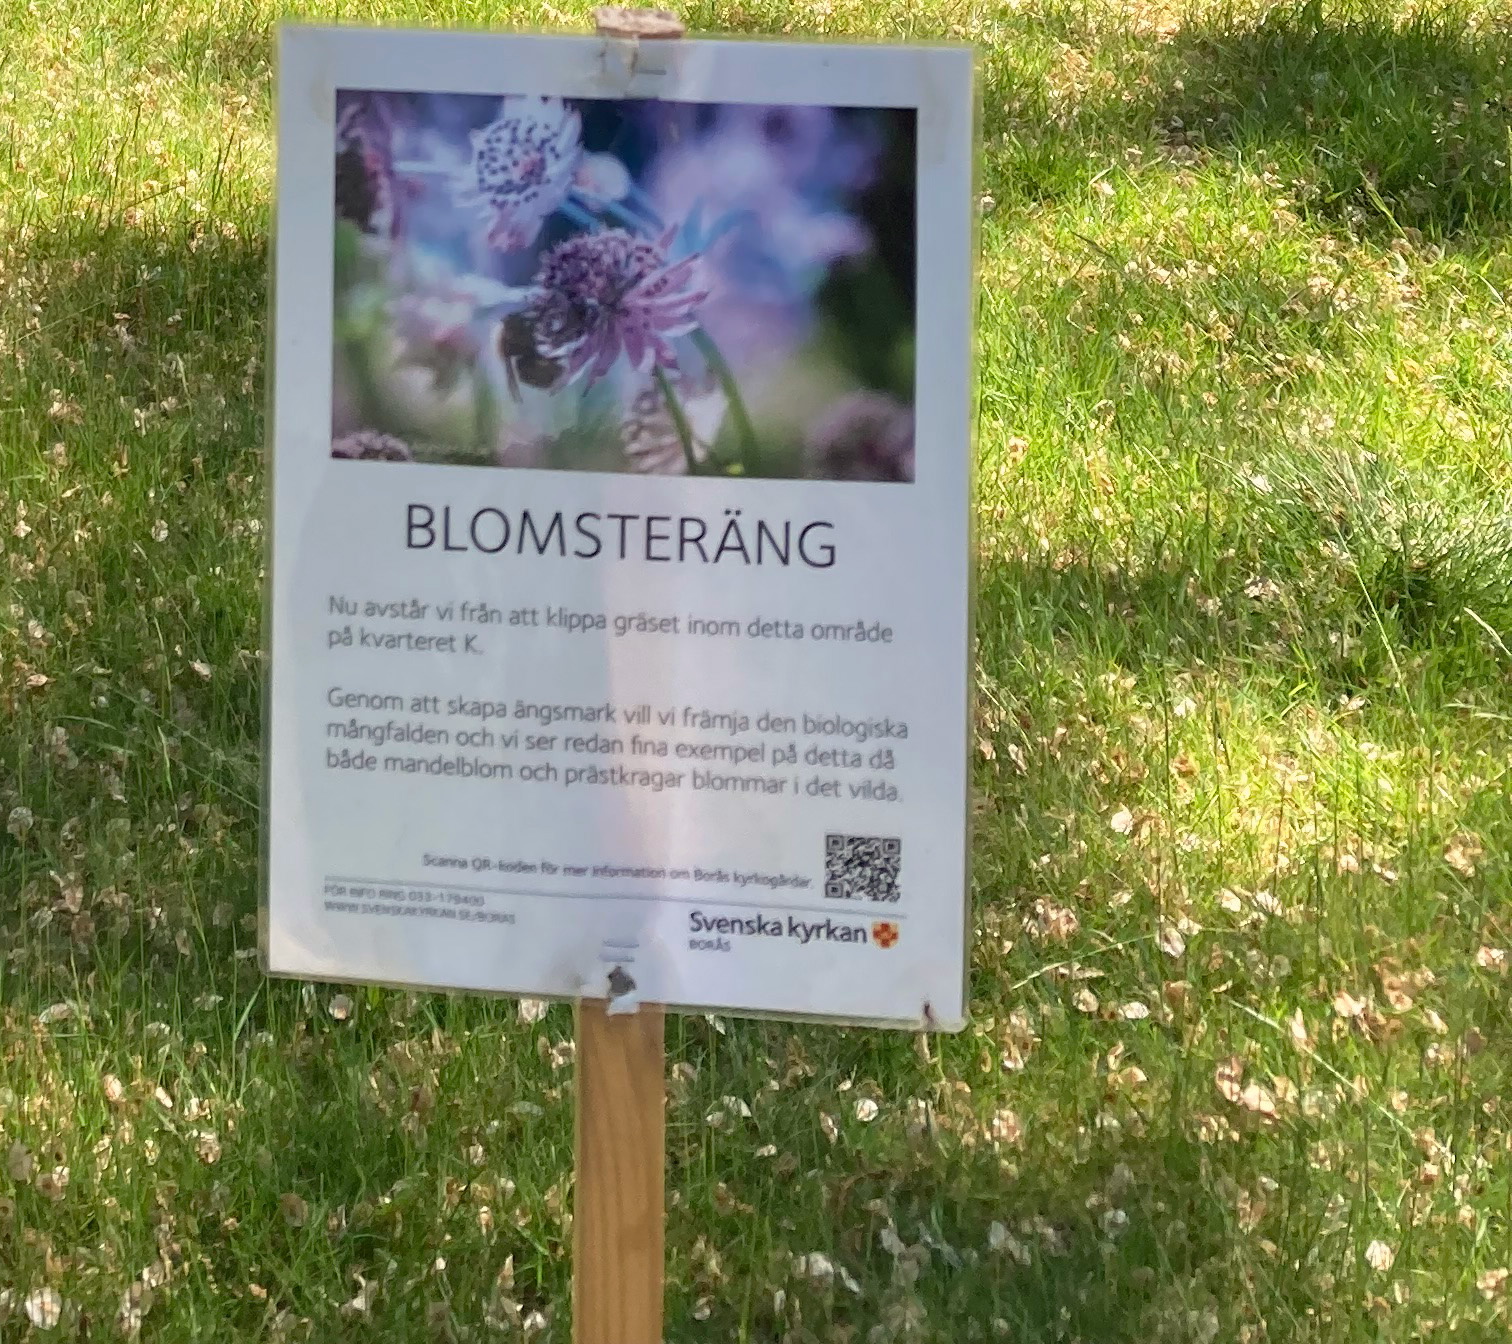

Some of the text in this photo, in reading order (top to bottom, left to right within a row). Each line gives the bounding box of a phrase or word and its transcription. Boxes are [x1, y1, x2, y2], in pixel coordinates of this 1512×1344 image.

[406, 504, 836, 568] BLOMSTERÄNG
[328, 625, 353, 648] på
[360, 628, 456, 651] kvarteret
[329, 596, 893, 642] Nu avstår vi från att klippa gräset inom detta område
[328, 687, 908, 742] Genom att skapa ängsmark vill vi främja den biologiska
[327, 718, 895, 770] mångfalden och vi ser redan fina exempel på detta då
[327, 748, 376, 770] både
[384, 754, 512, 779] mandelblom
[520, 762, 558, 782] och
[565, 764, 685, 792] prästkragar
[692, 770, 786, 794] blommar
[794, 776, 799, 794] i
[806, 775, 841, 798] det
[690, 911, 867, 944] Svenska kyrkan
